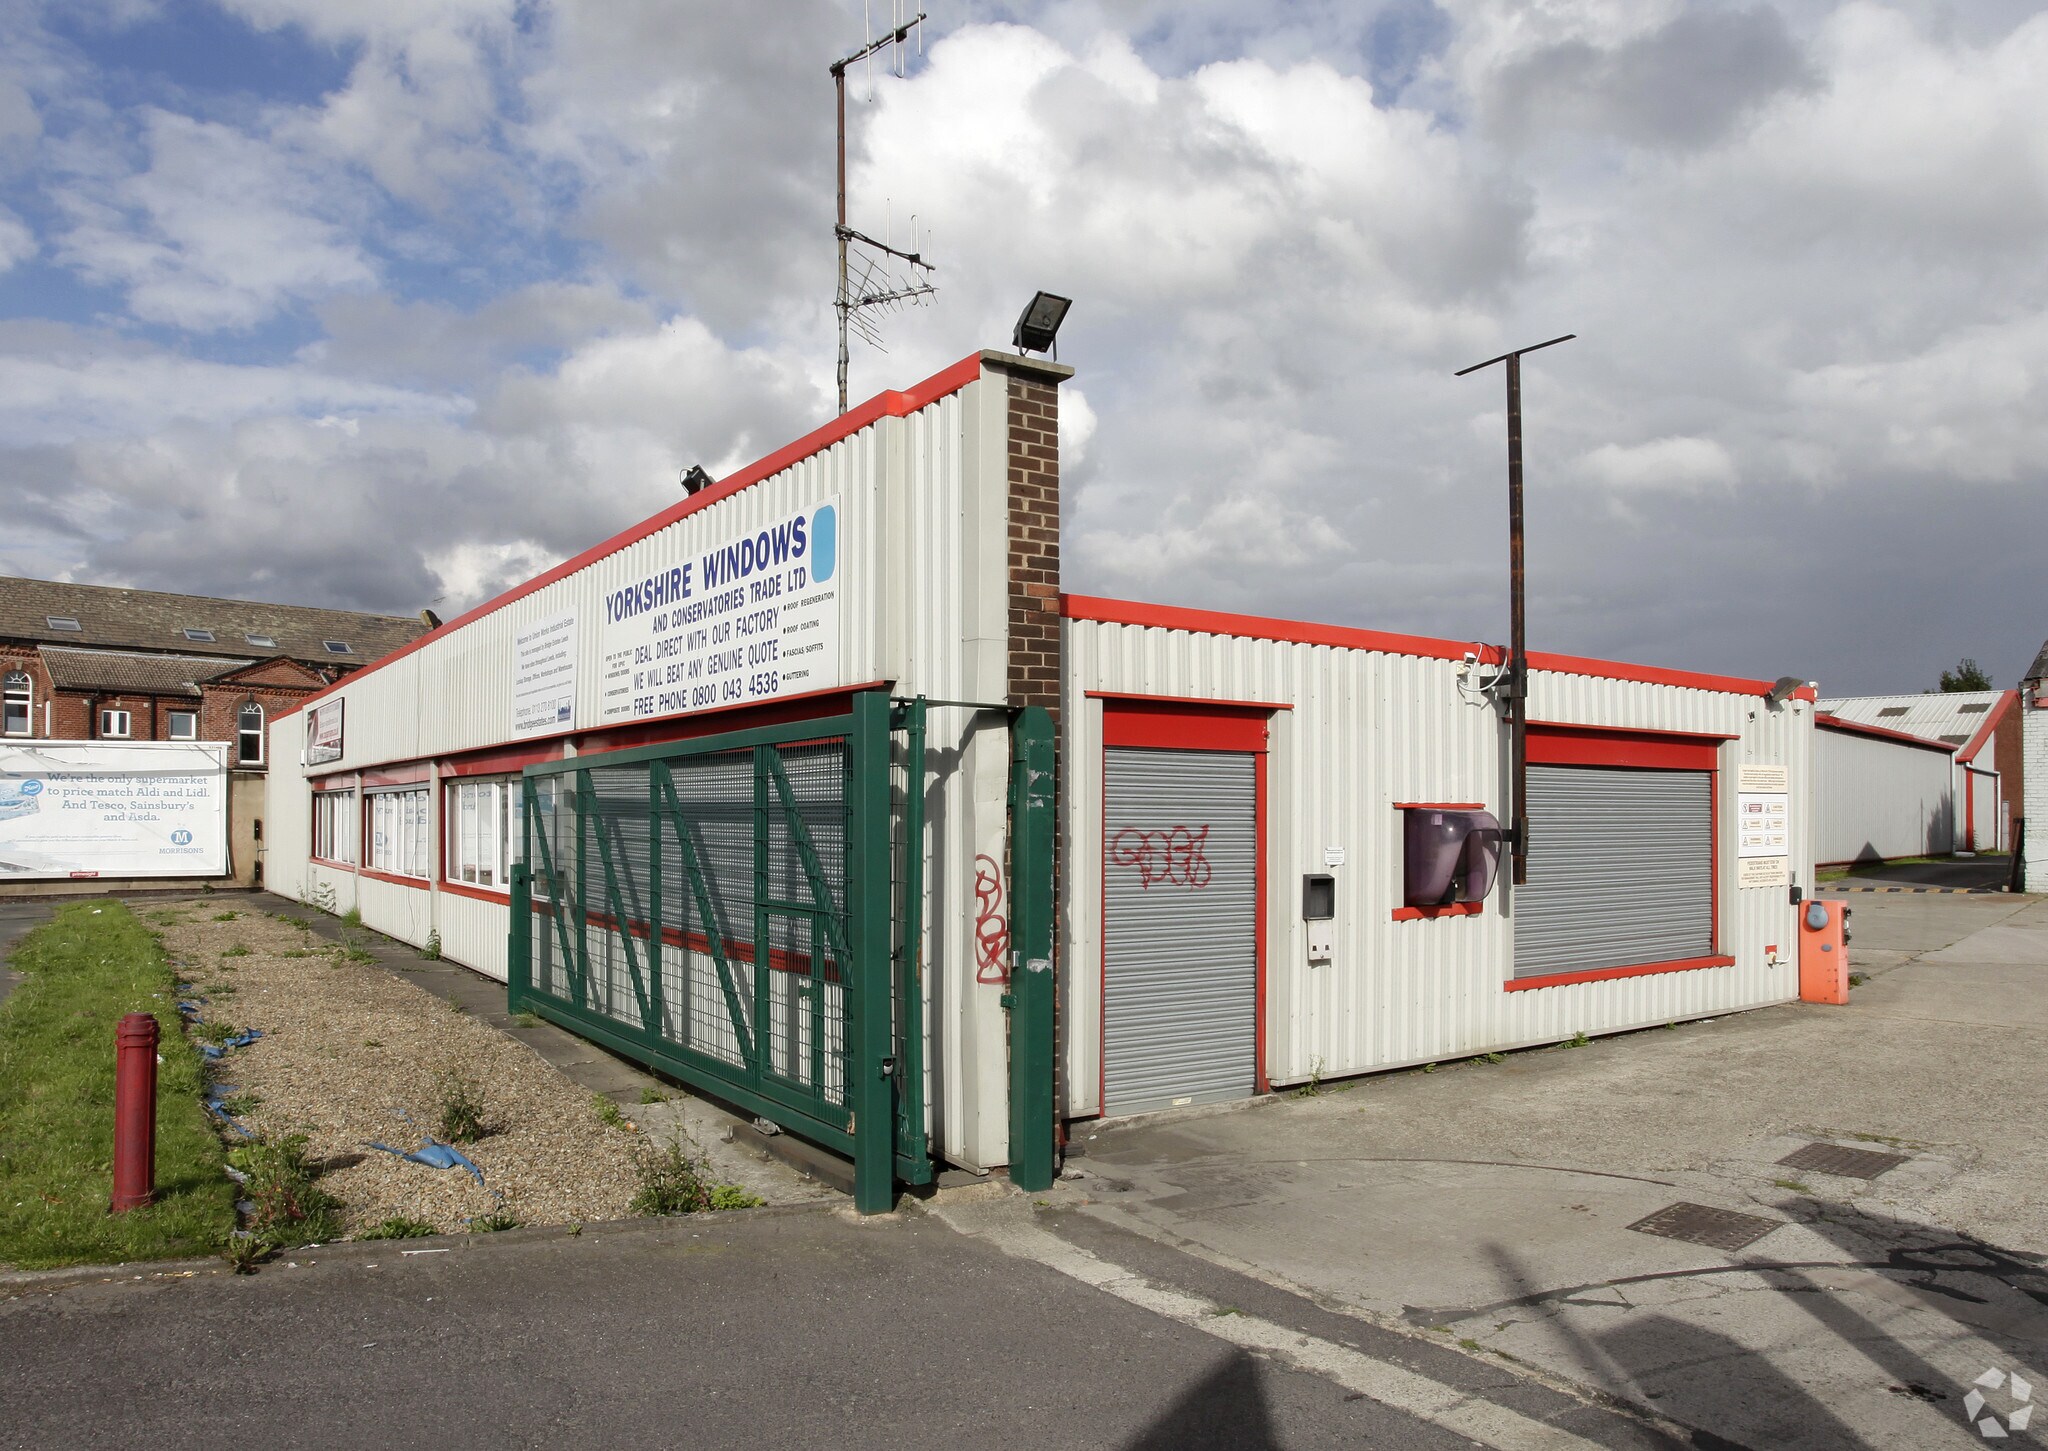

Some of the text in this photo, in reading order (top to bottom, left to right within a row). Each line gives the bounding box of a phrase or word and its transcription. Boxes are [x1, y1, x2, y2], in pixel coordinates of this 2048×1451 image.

[606, 515, 806, 625] YORKSHIRE WINDOWS
[653, 566, 806, 634] AND CONSERVATORIES TRADE LTD
[787, 591, 835, 611] ROOF REGENERATION
[787, 619, 820, 634] ROOF COATING
[635, 606, 780, 665] DEAL DIRECT WITH OUR FACTORY
[634, 639, 779, 690] WE WILL BEAT ANY GENUINE QUOTE
[786, 669, 809, 681] GUTTERING
[634, 670, 779, 716] FREE PHONE 0800 043 4536
[47, 772, 207, 785] We're the only supermarket
[63, 787, 94, 797] price
[97, 787, 133, 797] match
[136, 787, 160, 797] Aldi
[163, 788, 183, 797] and
[186, 788, 210, 798] Lidl.
[62, 800, 194, 812] And Tesco, Sainsbury's
[104, 812, 160, 821] and Asda.
[159, 847, 204, 855] MORRISONS
